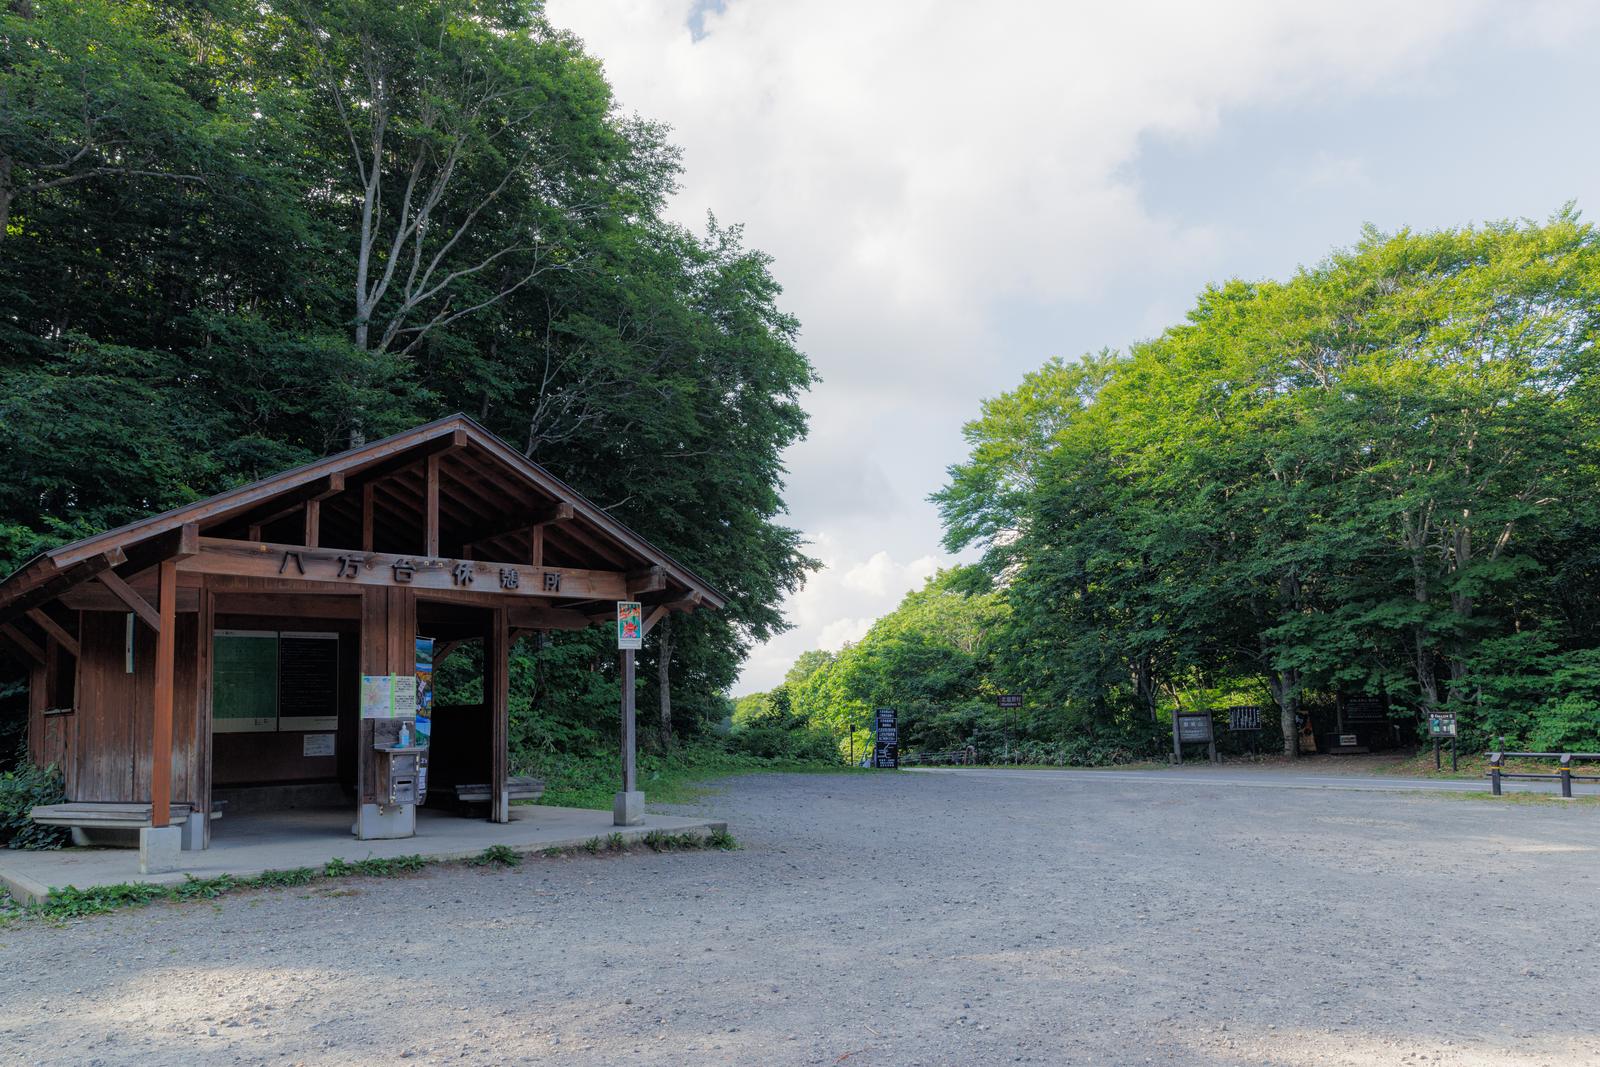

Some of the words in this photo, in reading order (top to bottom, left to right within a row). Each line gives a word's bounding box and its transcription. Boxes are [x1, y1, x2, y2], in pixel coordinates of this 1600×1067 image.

[279, 551, 561, 592] 八方台休憩所
